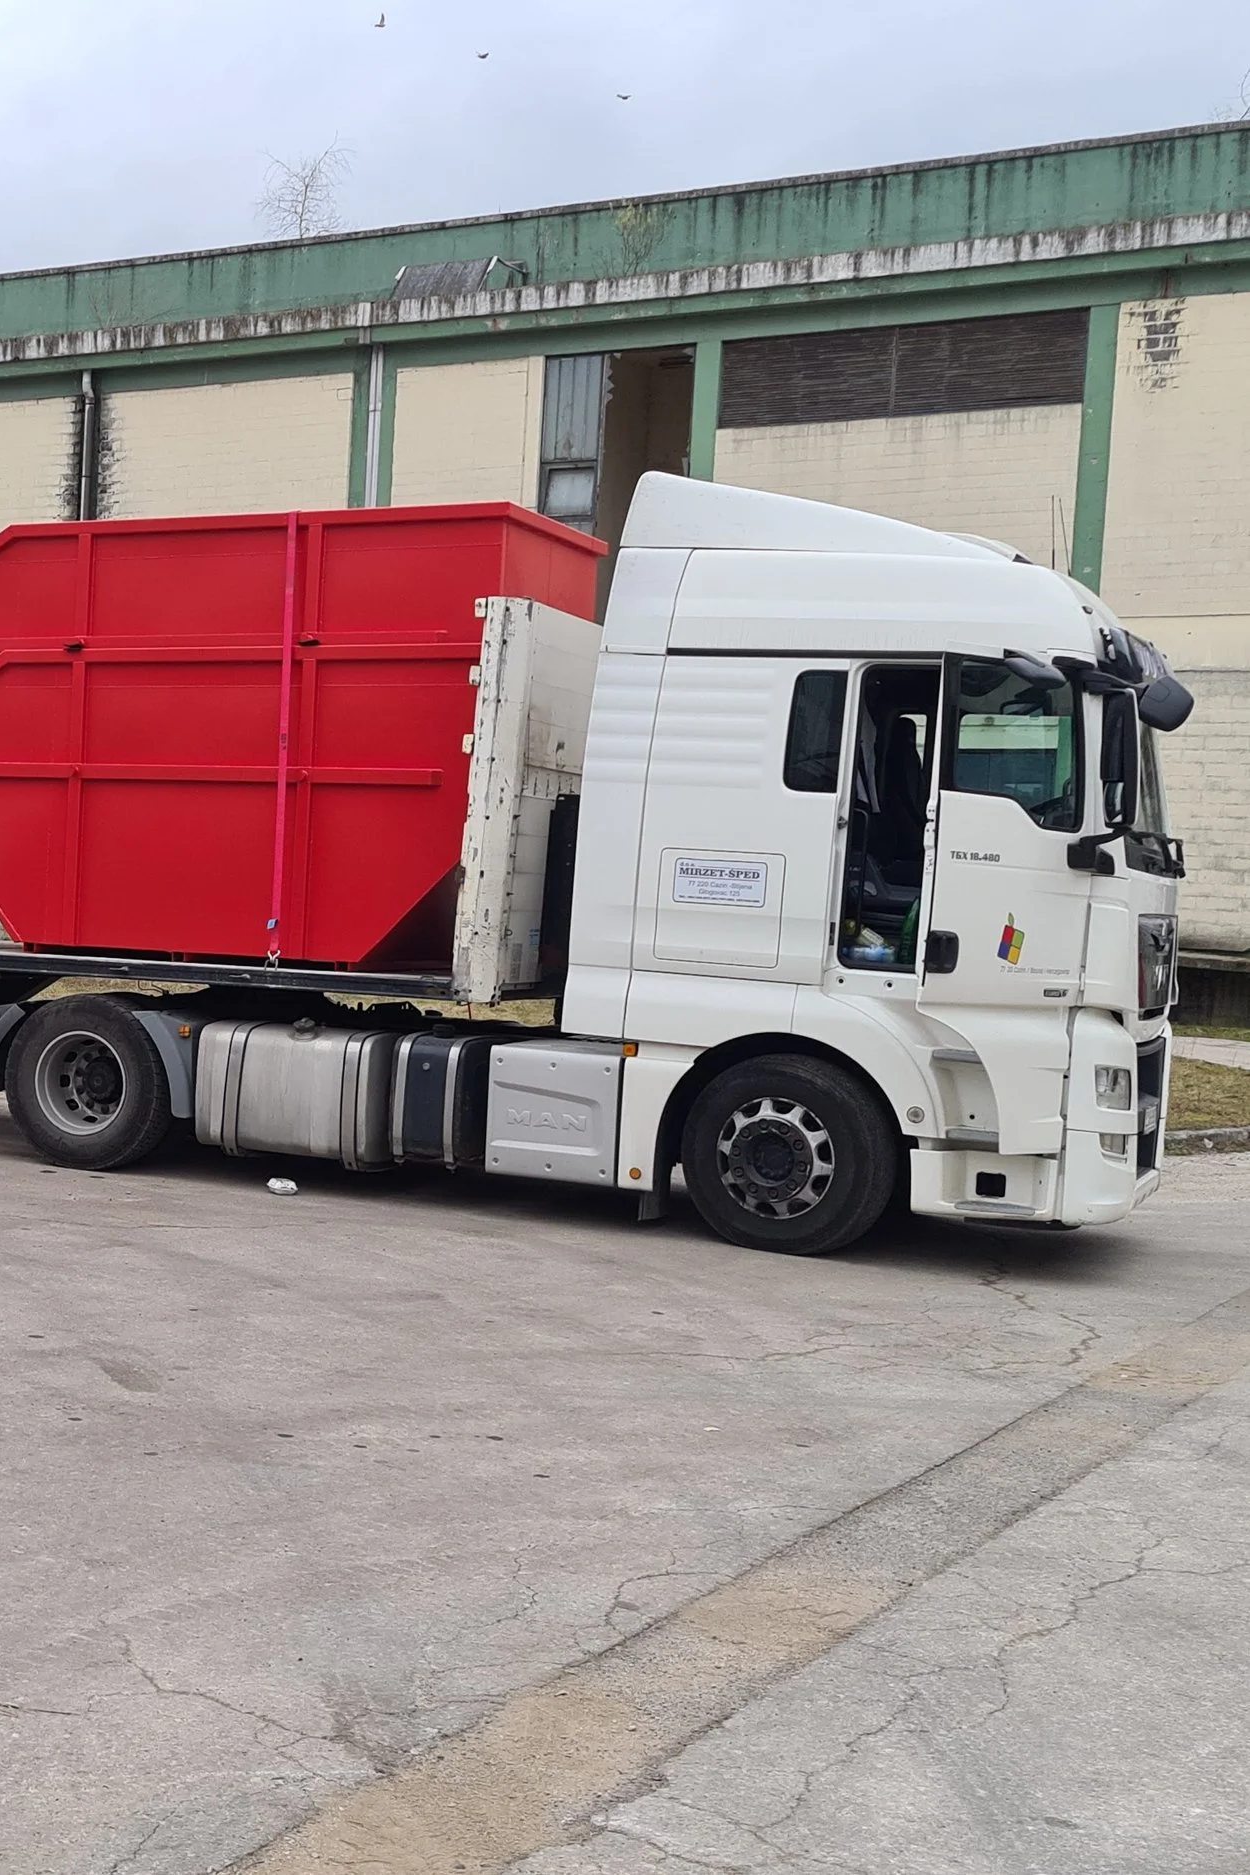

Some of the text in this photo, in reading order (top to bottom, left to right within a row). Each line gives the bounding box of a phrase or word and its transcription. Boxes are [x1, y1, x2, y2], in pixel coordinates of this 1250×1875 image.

[950, 850, 1000, 862] TGX 18.480
[506, 1108, 588, 1132] MAN
